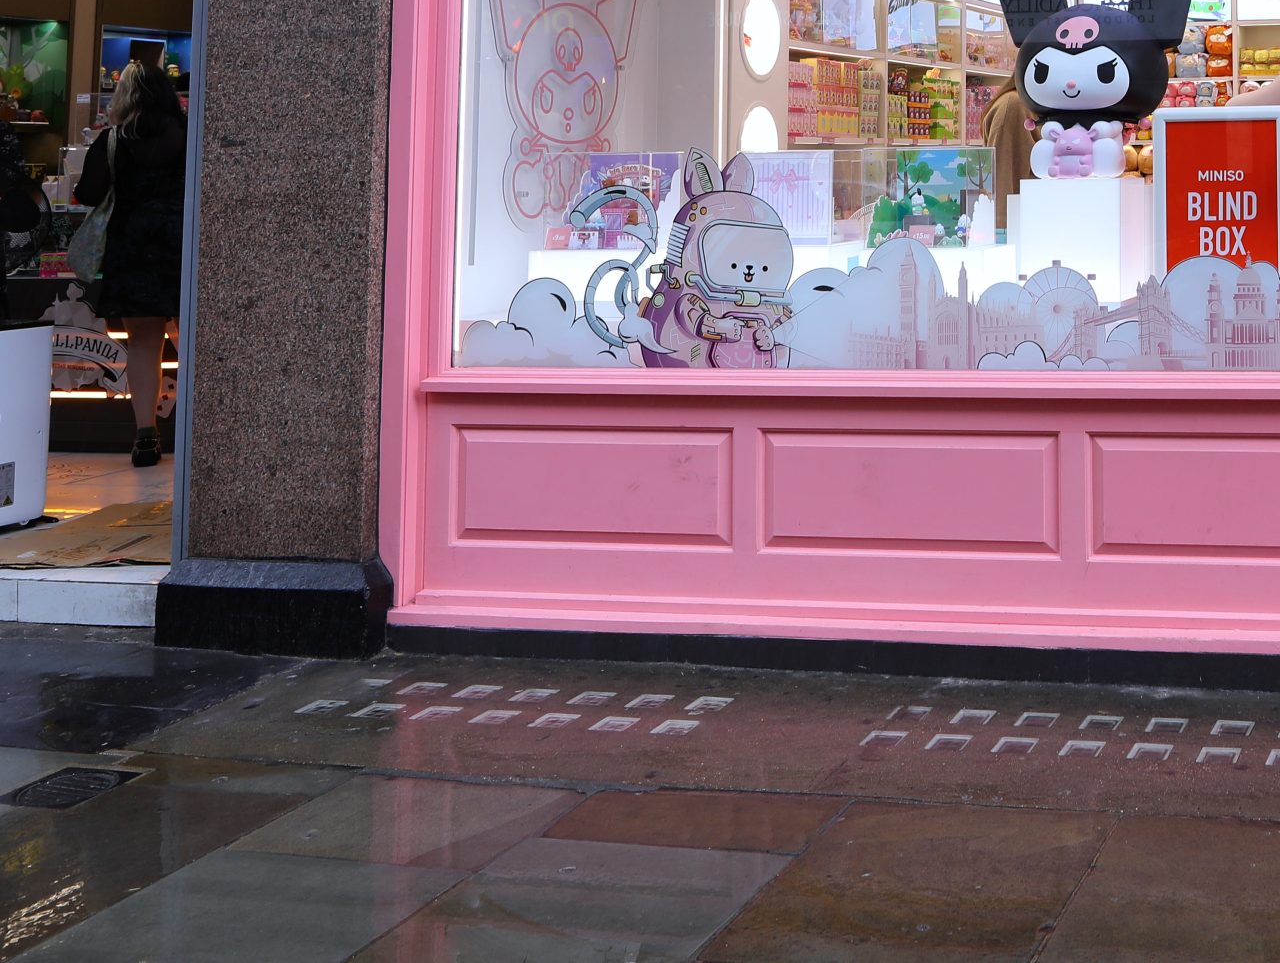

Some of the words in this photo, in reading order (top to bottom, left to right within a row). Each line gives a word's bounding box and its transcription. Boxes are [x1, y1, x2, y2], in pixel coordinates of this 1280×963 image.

[1198, 170, 1245, 182] MINISO
[1187, 191, 1258, 221] BLIND
[1199, 226, 1247, 256] BOX
[55, 333, 119, 364] LLPANDA
